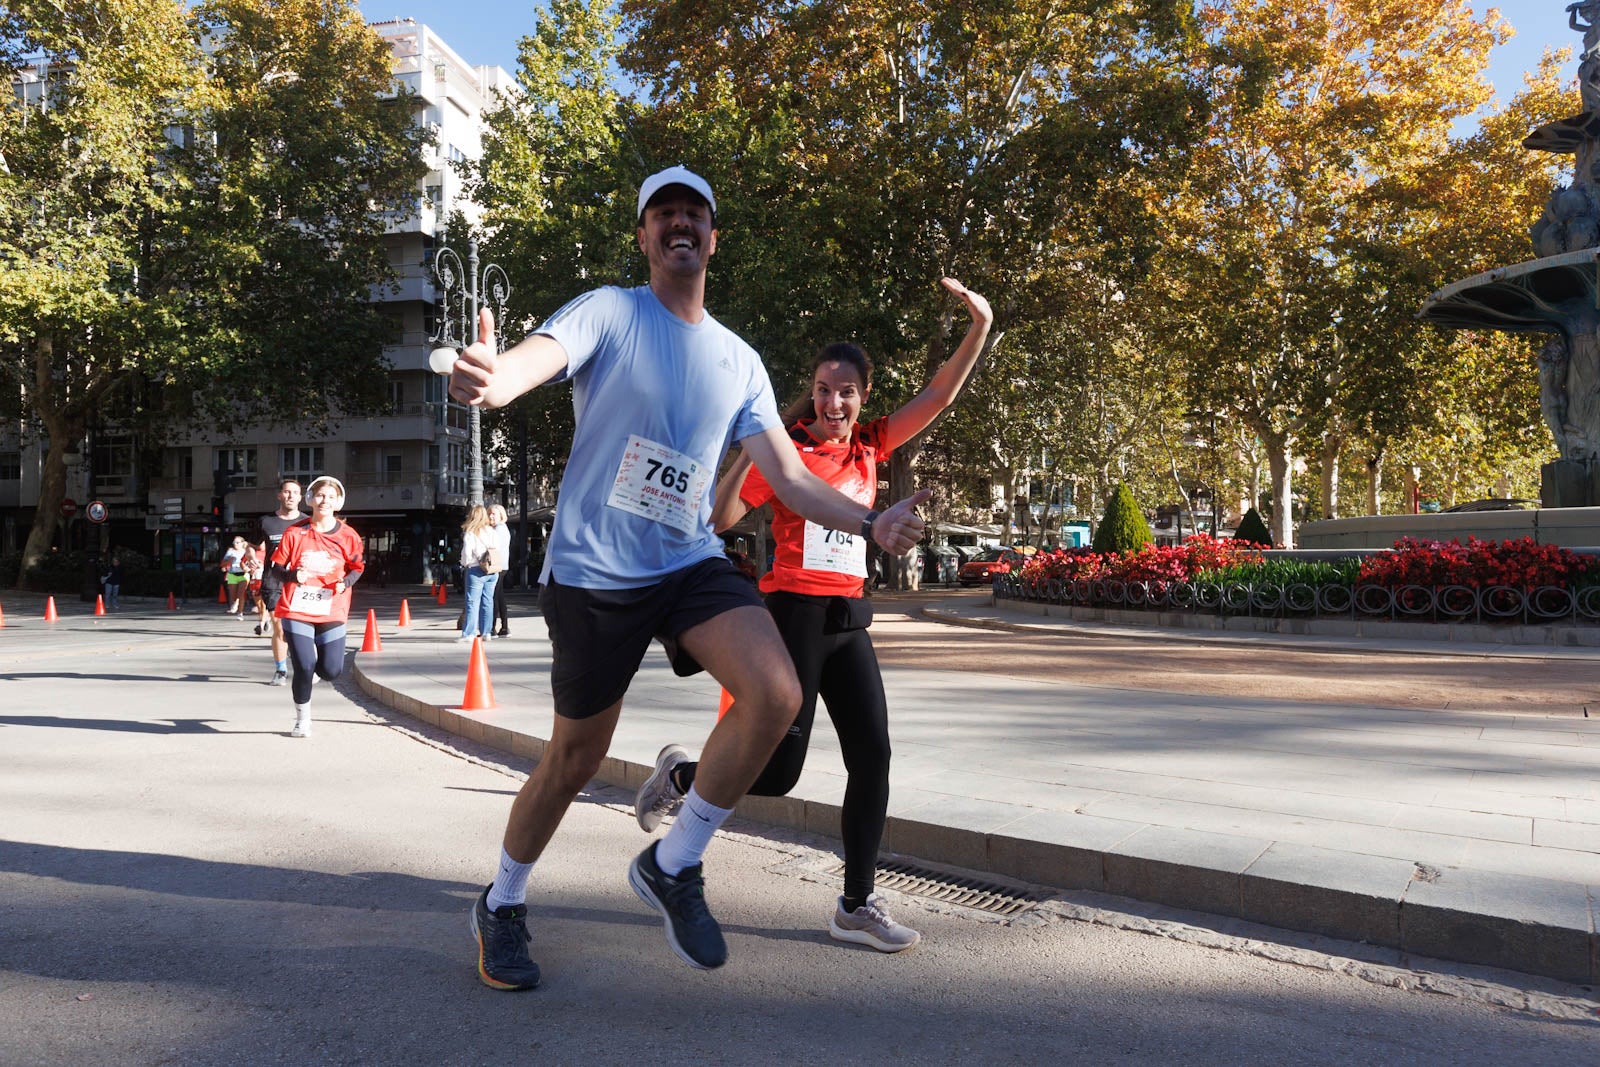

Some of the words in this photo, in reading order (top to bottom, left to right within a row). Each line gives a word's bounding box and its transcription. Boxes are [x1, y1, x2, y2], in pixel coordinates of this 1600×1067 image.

[645, 458, 690, 493] 765
[641, 485, 659, 496] JOSE
[823, 527, 853, 548] 764
[302, 591, 322, 602] 253
